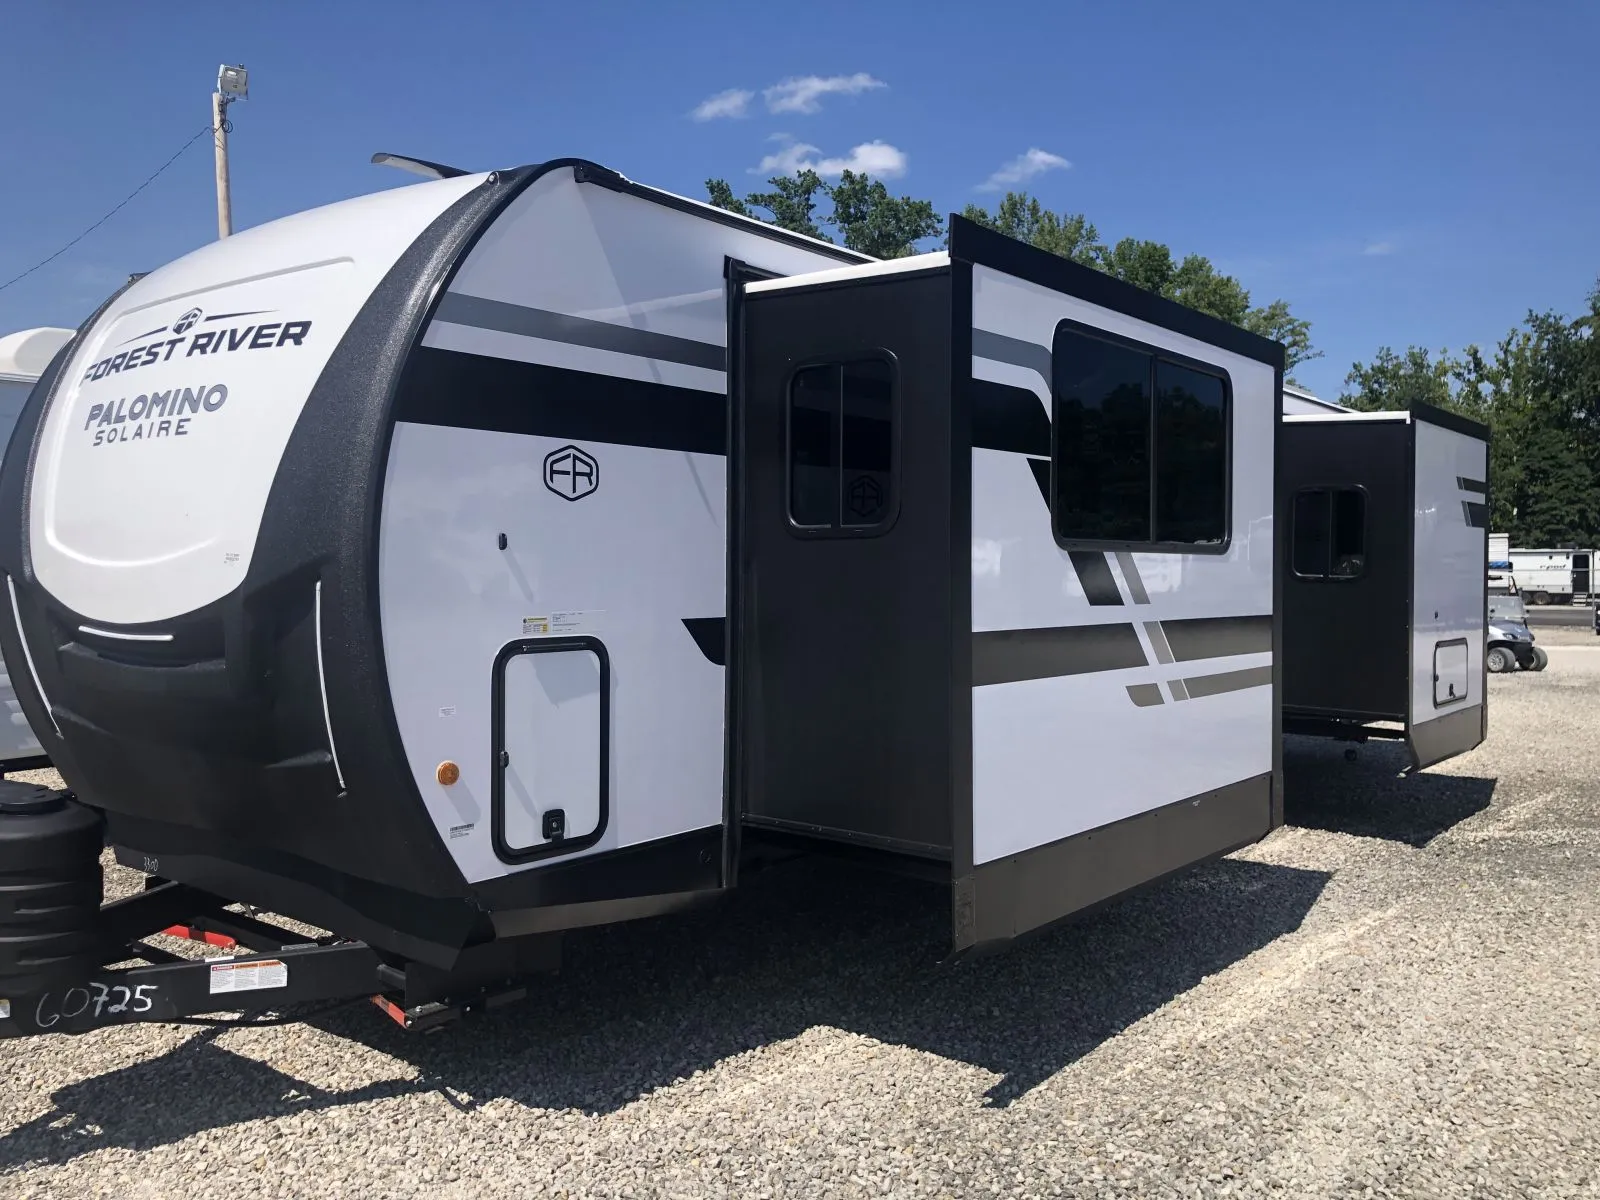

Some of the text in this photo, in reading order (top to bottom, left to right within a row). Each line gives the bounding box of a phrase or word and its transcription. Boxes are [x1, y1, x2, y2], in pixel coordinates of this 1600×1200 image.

[79, 320, 313, 387] FOREST RIVER
[84, 383, 228, 431] PALOMINO
[93, 418, 192, 446] SOLAIRE
[548, 451, 595, 495] FR
[36, 982, 159, 1028] 60725
